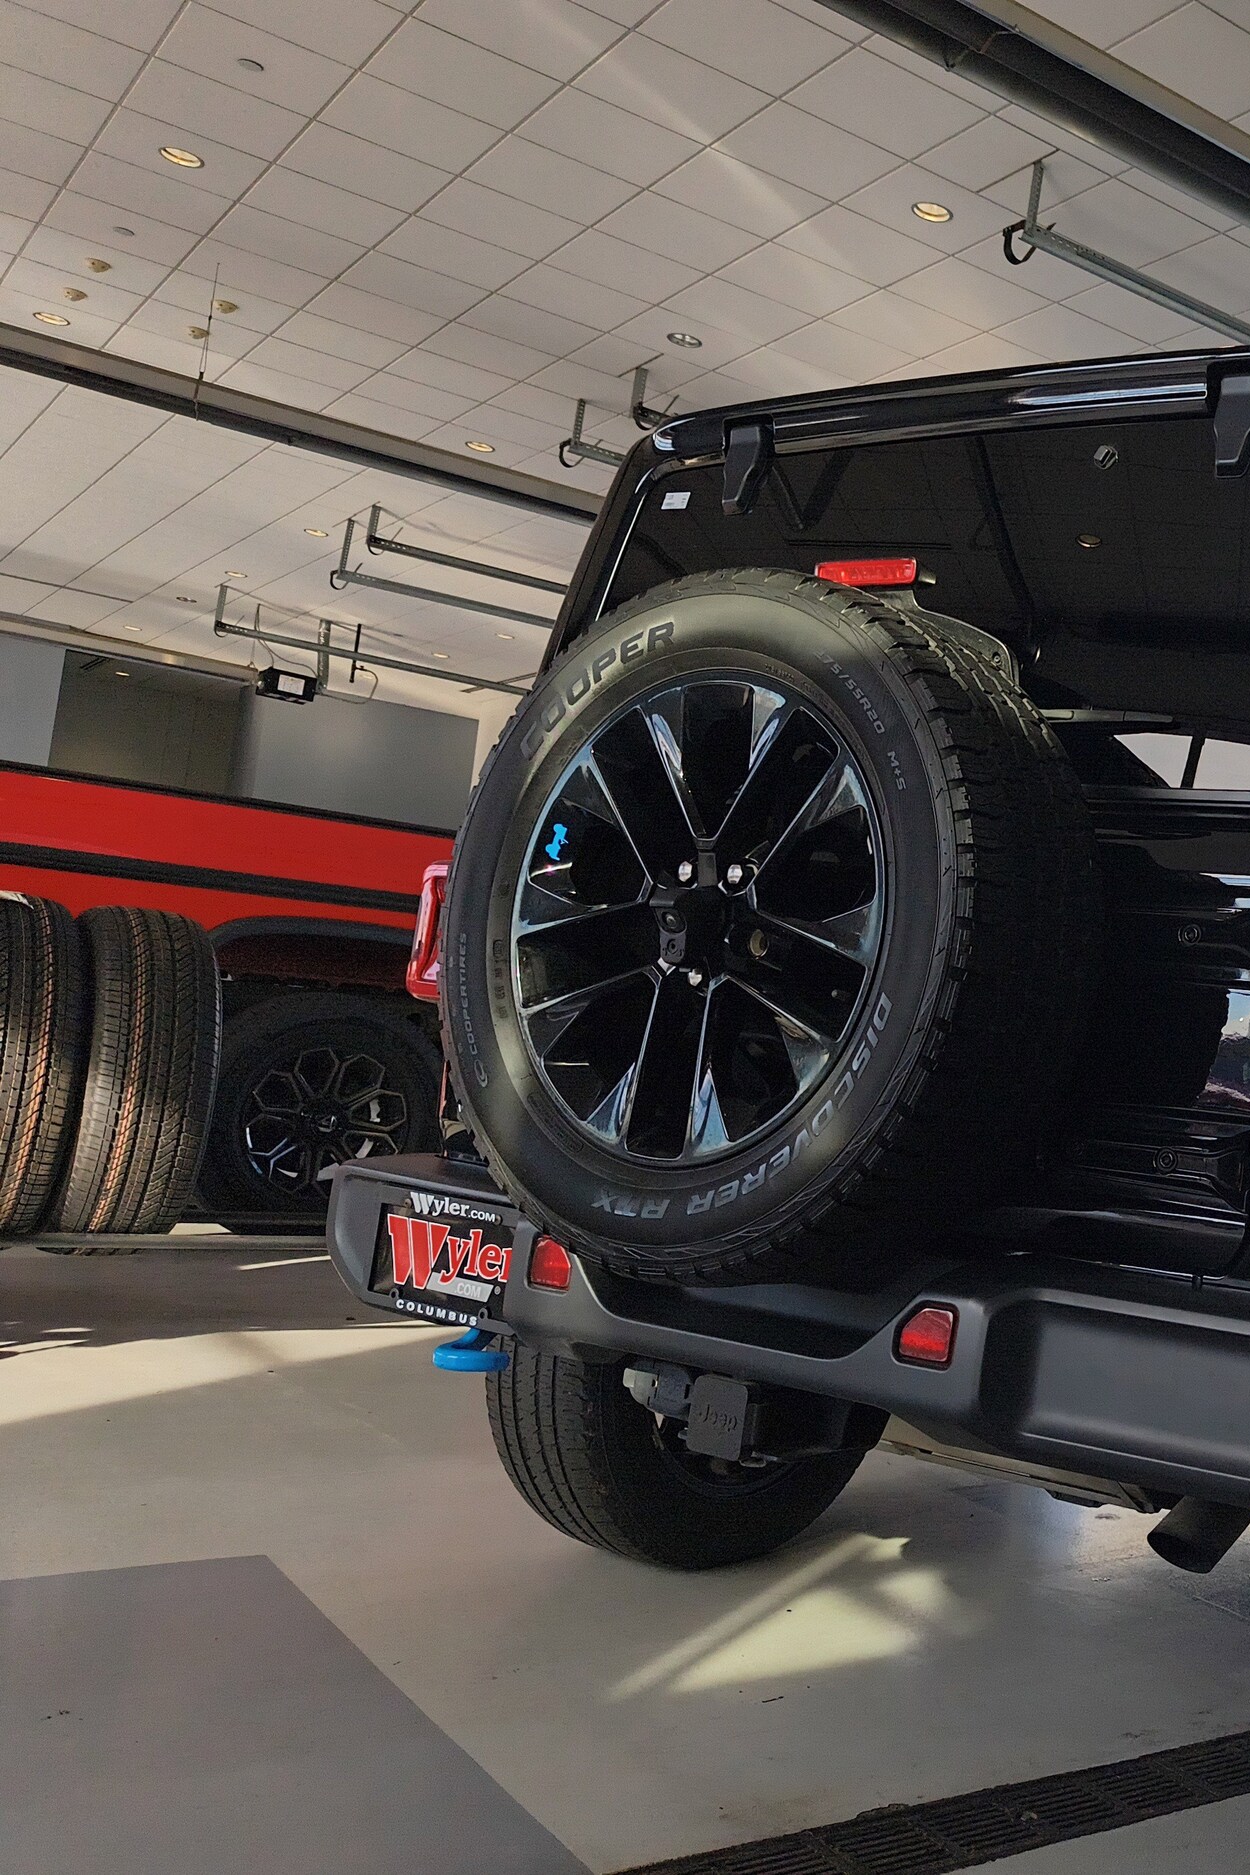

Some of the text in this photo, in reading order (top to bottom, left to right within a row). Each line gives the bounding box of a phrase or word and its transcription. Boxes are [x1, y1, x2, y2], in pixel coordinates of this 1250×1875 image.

[520, 621, 674, 761] COOPER
[887, 751, 907, 790] M+S
[686, 991, 893, 1216] DISCOVERER
[591, 1192, 671, 1219] RTX
[395, 1298, 478, 1327] COLUMBUS
